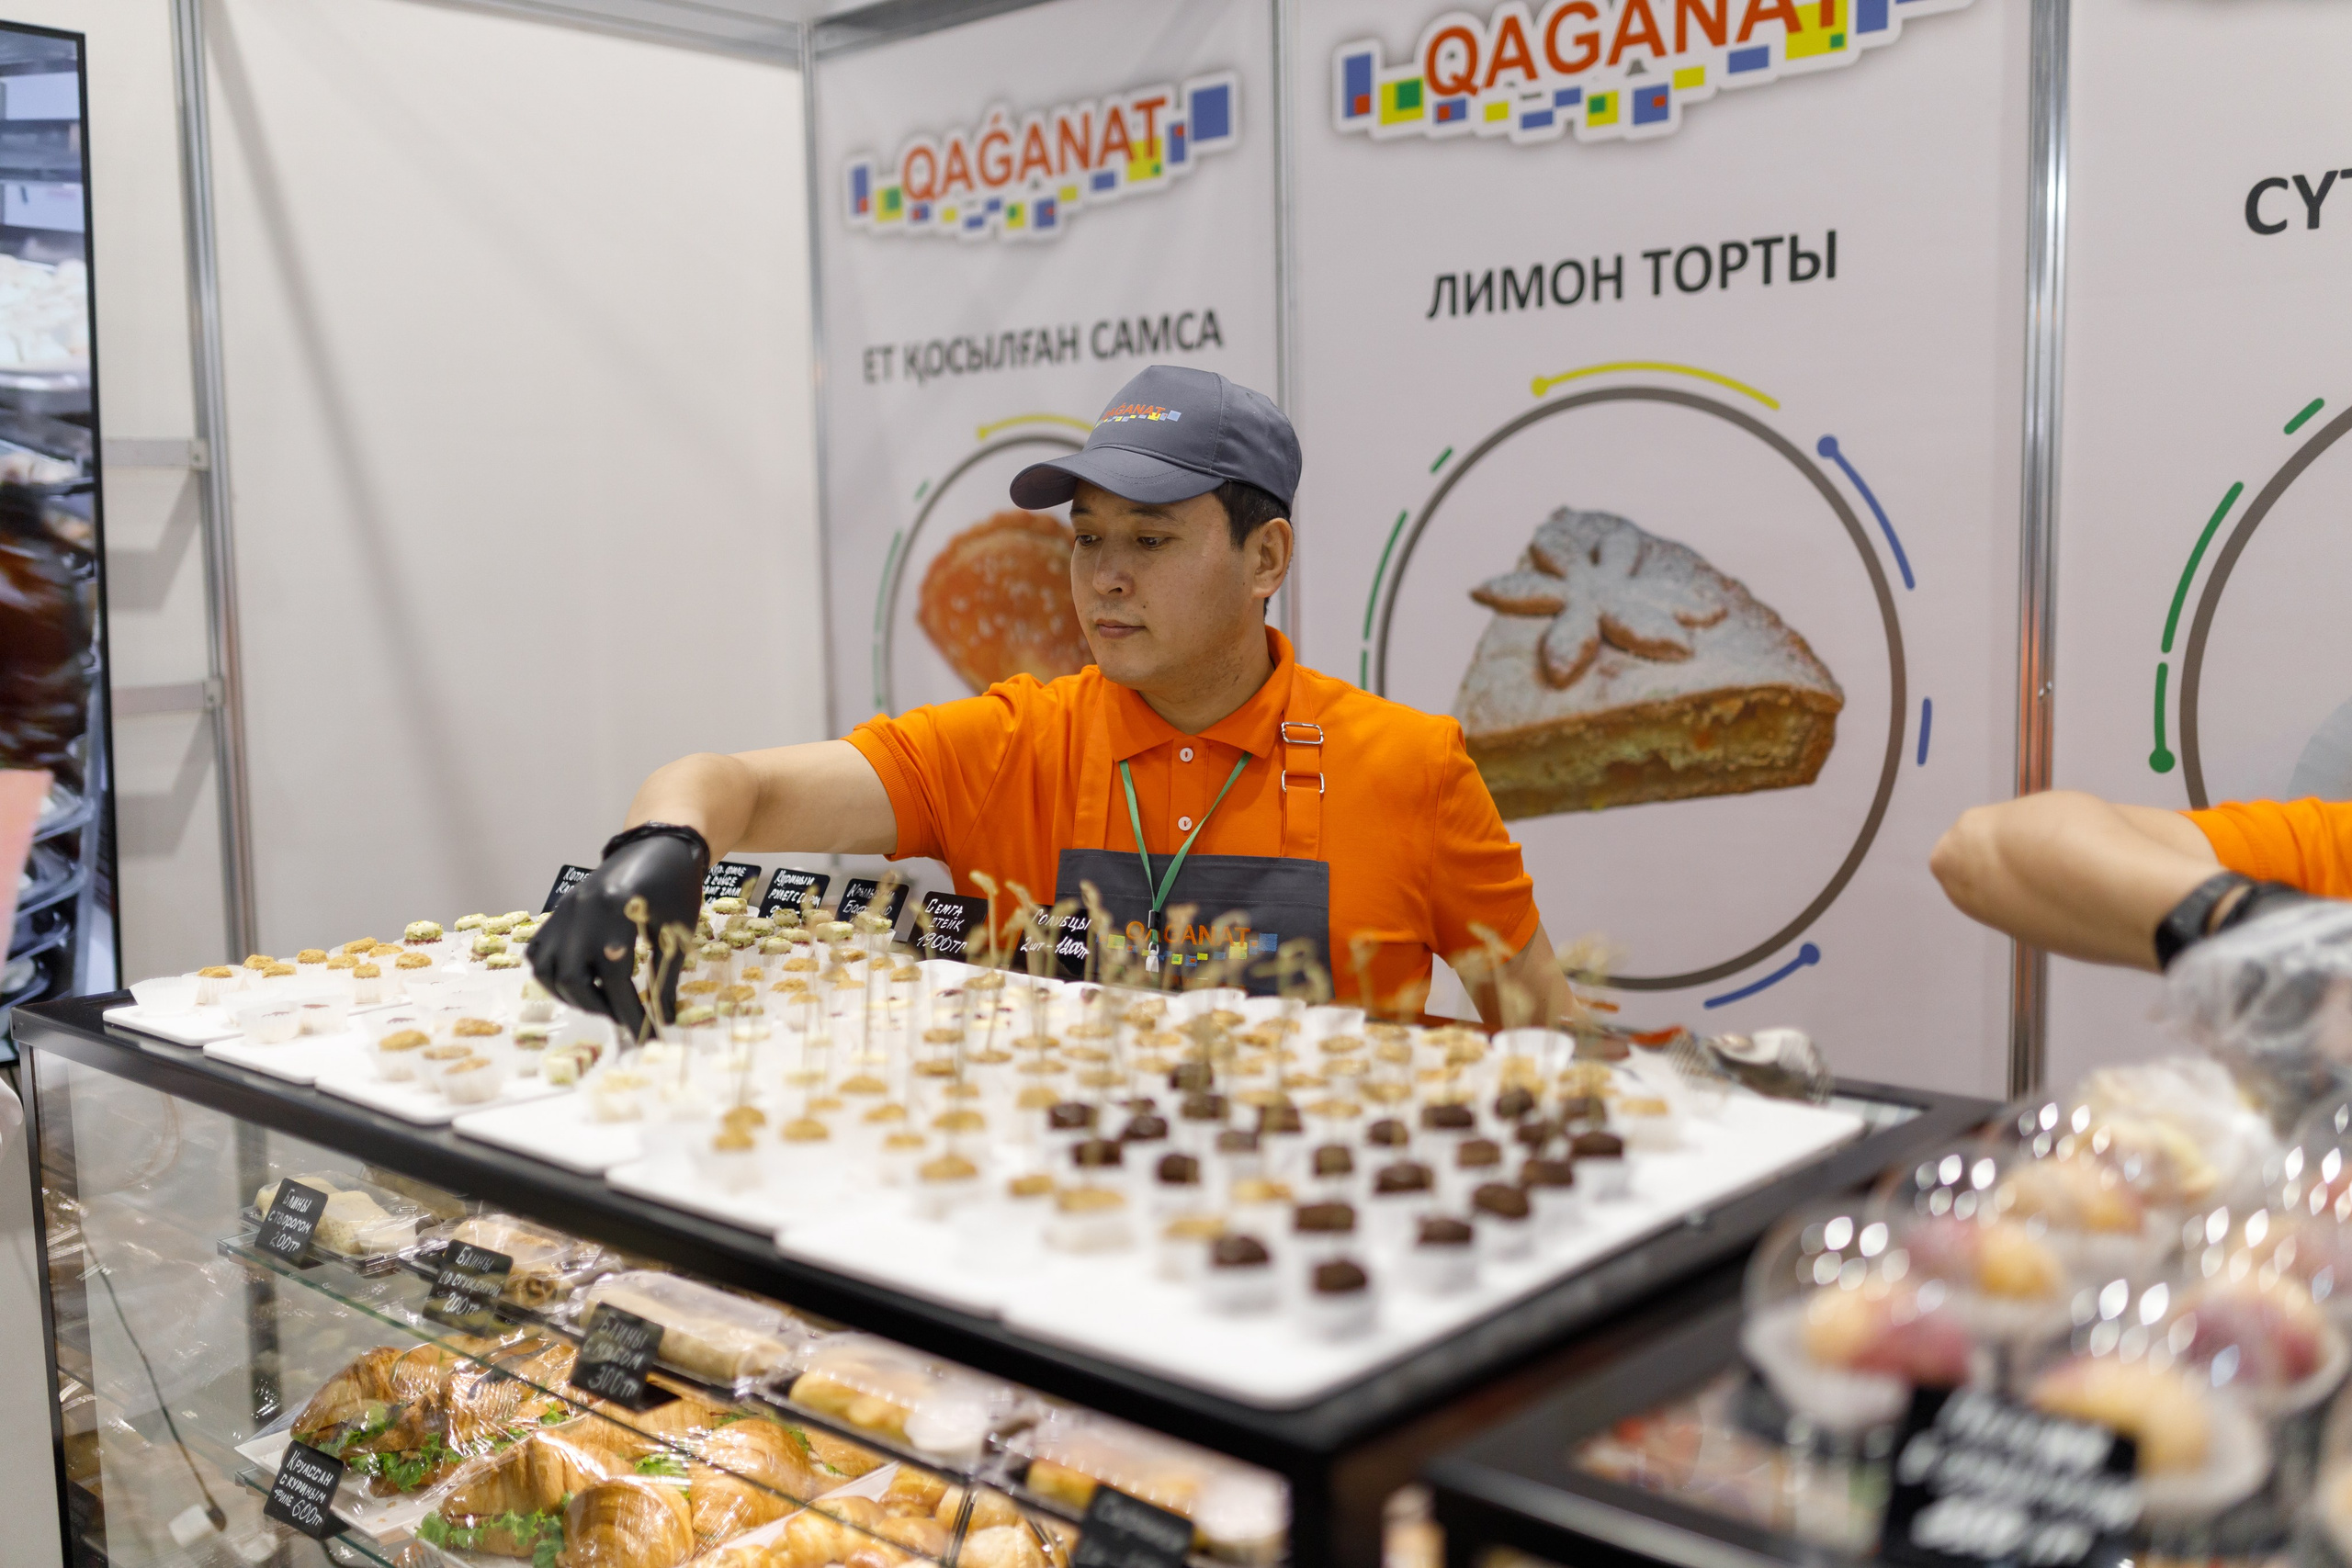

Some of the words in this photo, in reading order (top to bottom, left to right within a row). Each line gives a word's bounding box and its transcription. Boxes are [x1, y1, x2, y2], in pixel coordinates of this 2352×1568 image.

[1426, 253, 1625, 321] ЛИМОН
[1641, 229, 1839, 299] ТОРТЫ
[862, 345, 897, 384] ЕТ
[1090, 308, 1225, 360] САМСА
